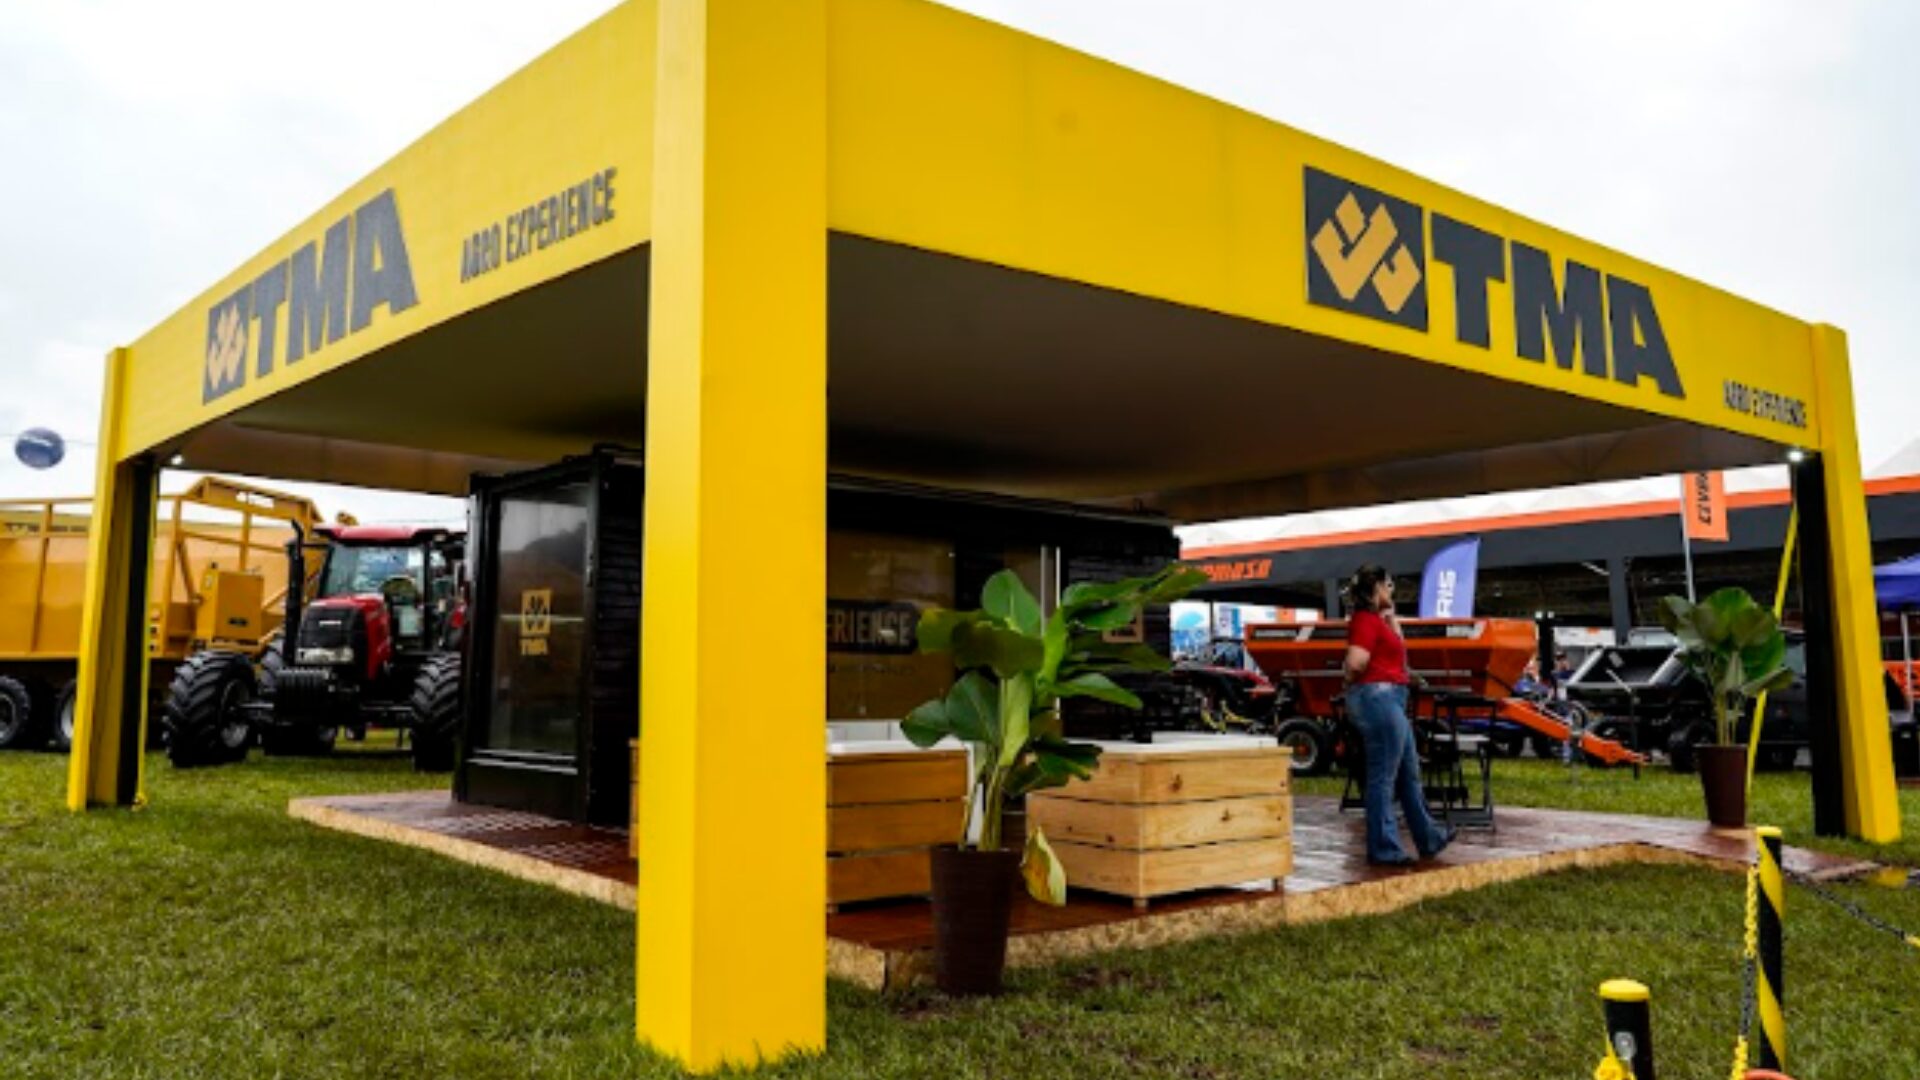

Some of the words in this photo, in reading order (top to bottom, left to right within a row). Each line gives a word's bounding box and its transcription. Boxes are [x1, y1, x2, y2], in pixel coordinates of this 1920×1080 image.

[251, 187, 420, 379] TMA
[461, 221, 501, 284] AGRO
[506, 166, 617, 263] EXPERIENCE
[1430, 210, 1686, 398] TMA
[827, 607, 911, 647] ERIENCE
